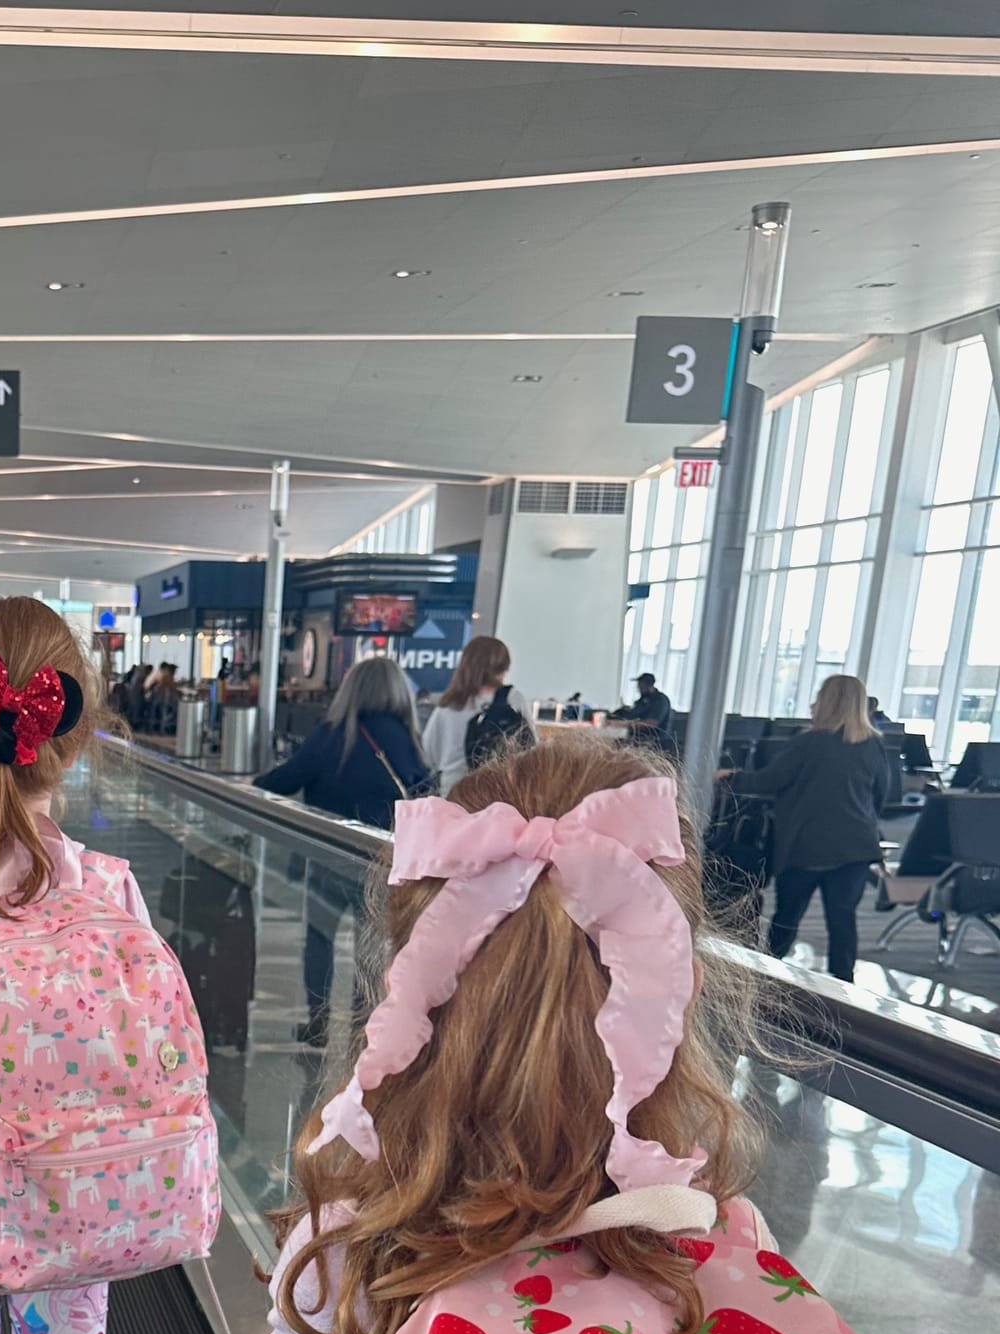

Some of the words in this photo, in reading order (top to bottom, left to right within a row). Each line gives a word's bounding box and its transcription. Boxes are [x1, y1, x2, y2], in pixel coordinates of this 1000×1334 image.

[663, 344, 697, 397] 3
[679, 461, 713, 488] EXIT
[400, 648, 464, 670] MPHI
